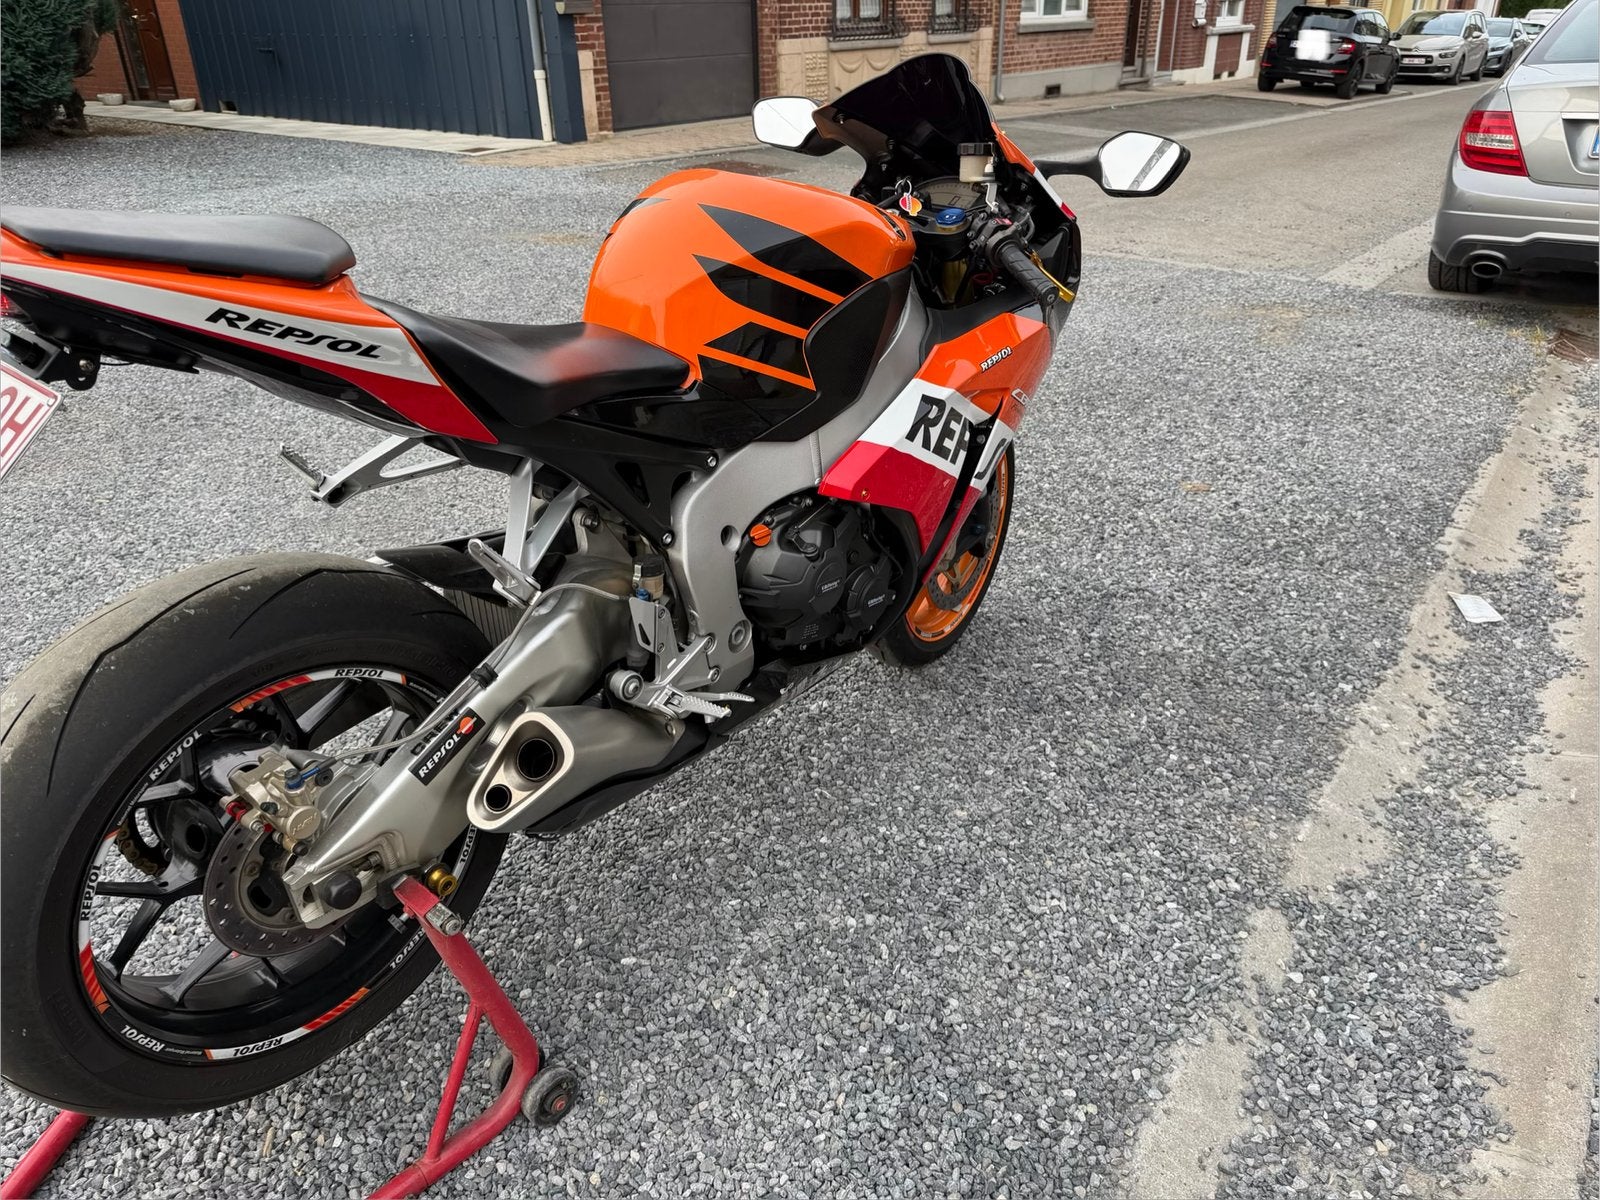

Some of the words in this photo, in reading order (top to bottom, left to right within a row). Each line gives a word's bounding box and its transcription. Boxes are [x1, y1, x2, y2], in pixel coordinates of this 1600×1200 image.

[205, 308, 381, 359] REPSOL
[334, 668, 384, 678] REPSOL
[149, 730, 202, 781] REPSOL
[418, 733, 461, 778] REPSOL
[80, 864, 102, 921] REPSOL
[120, 1024, 166, 1053] REPSOL
[233, 1036, 284, 1058] REPSOL
